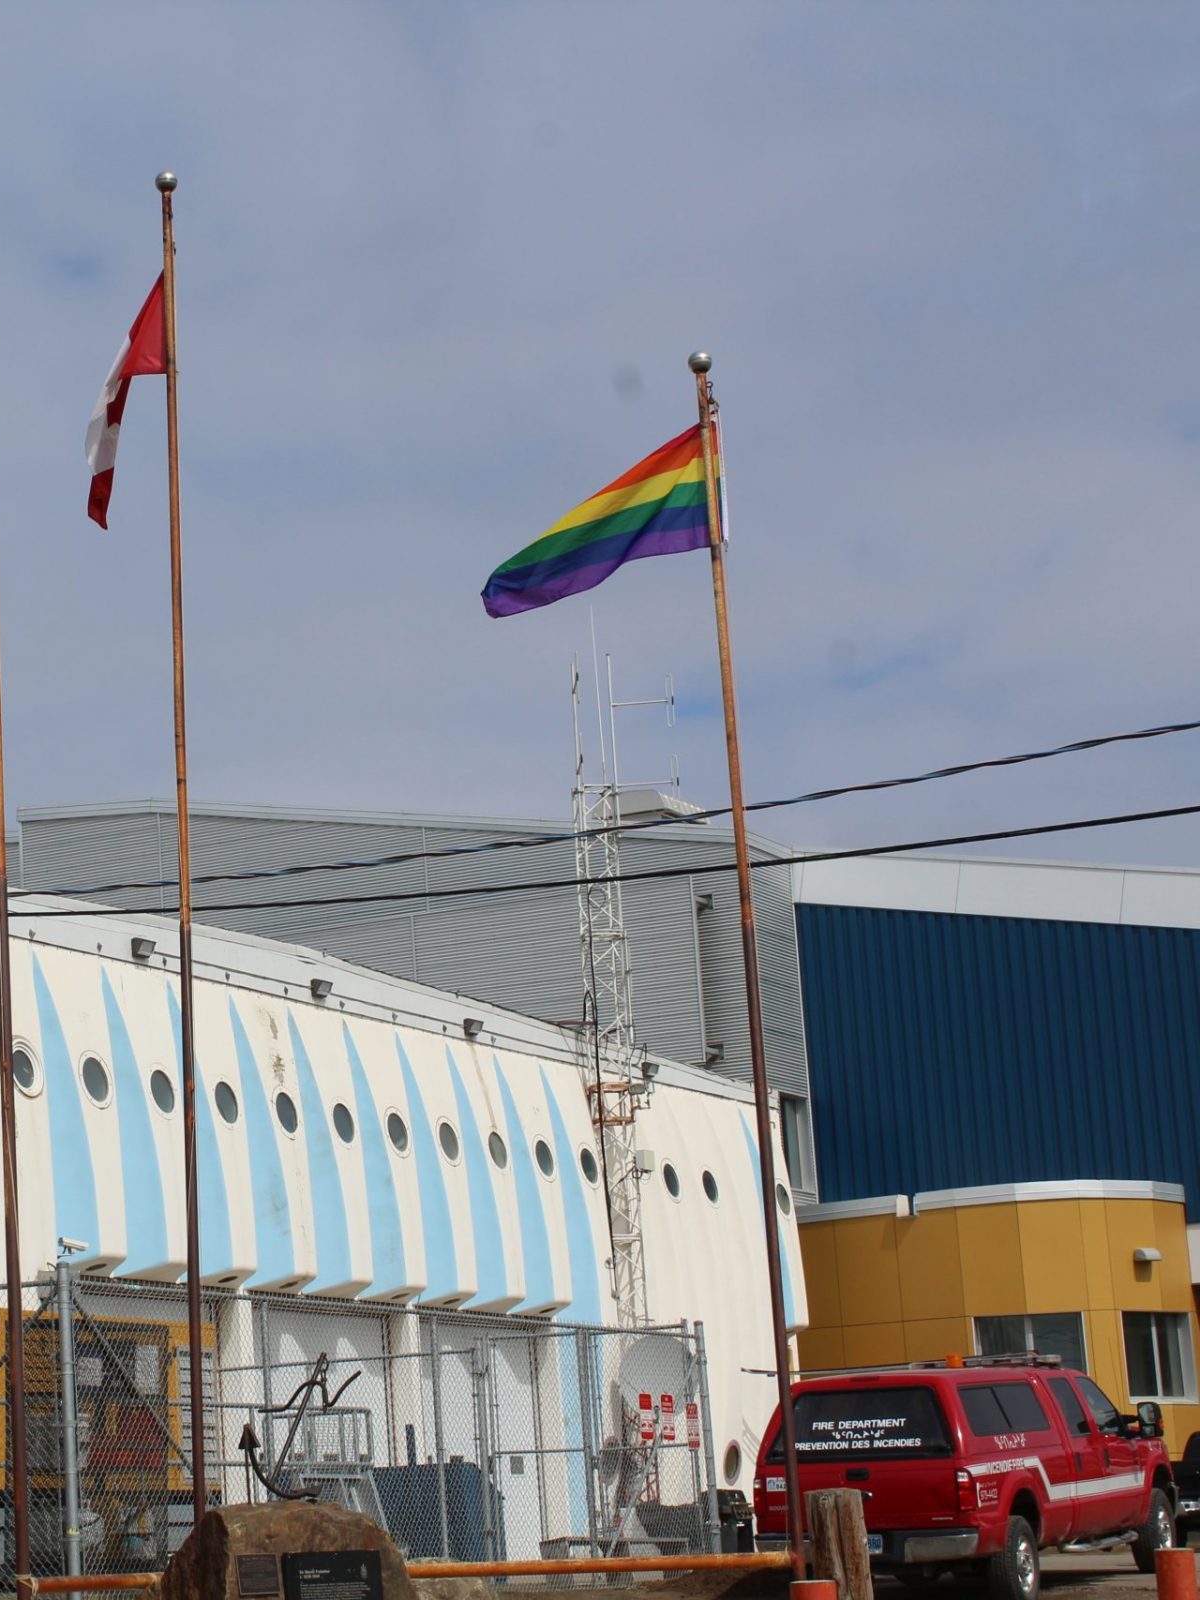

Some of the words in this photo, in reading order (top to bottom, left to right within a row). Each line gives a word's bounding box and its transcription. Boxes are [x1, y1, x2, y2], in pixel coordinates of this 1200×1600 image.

[812, 1421, 835, 1431] FIRE
[838, 1417, 906, 1430] DEPARTMENT
[794, 1440, 849, 1451] PREVENTION
[851, 1440, 870, 1449] DES
[873, 1438, 922, 1448] INCENDIES
